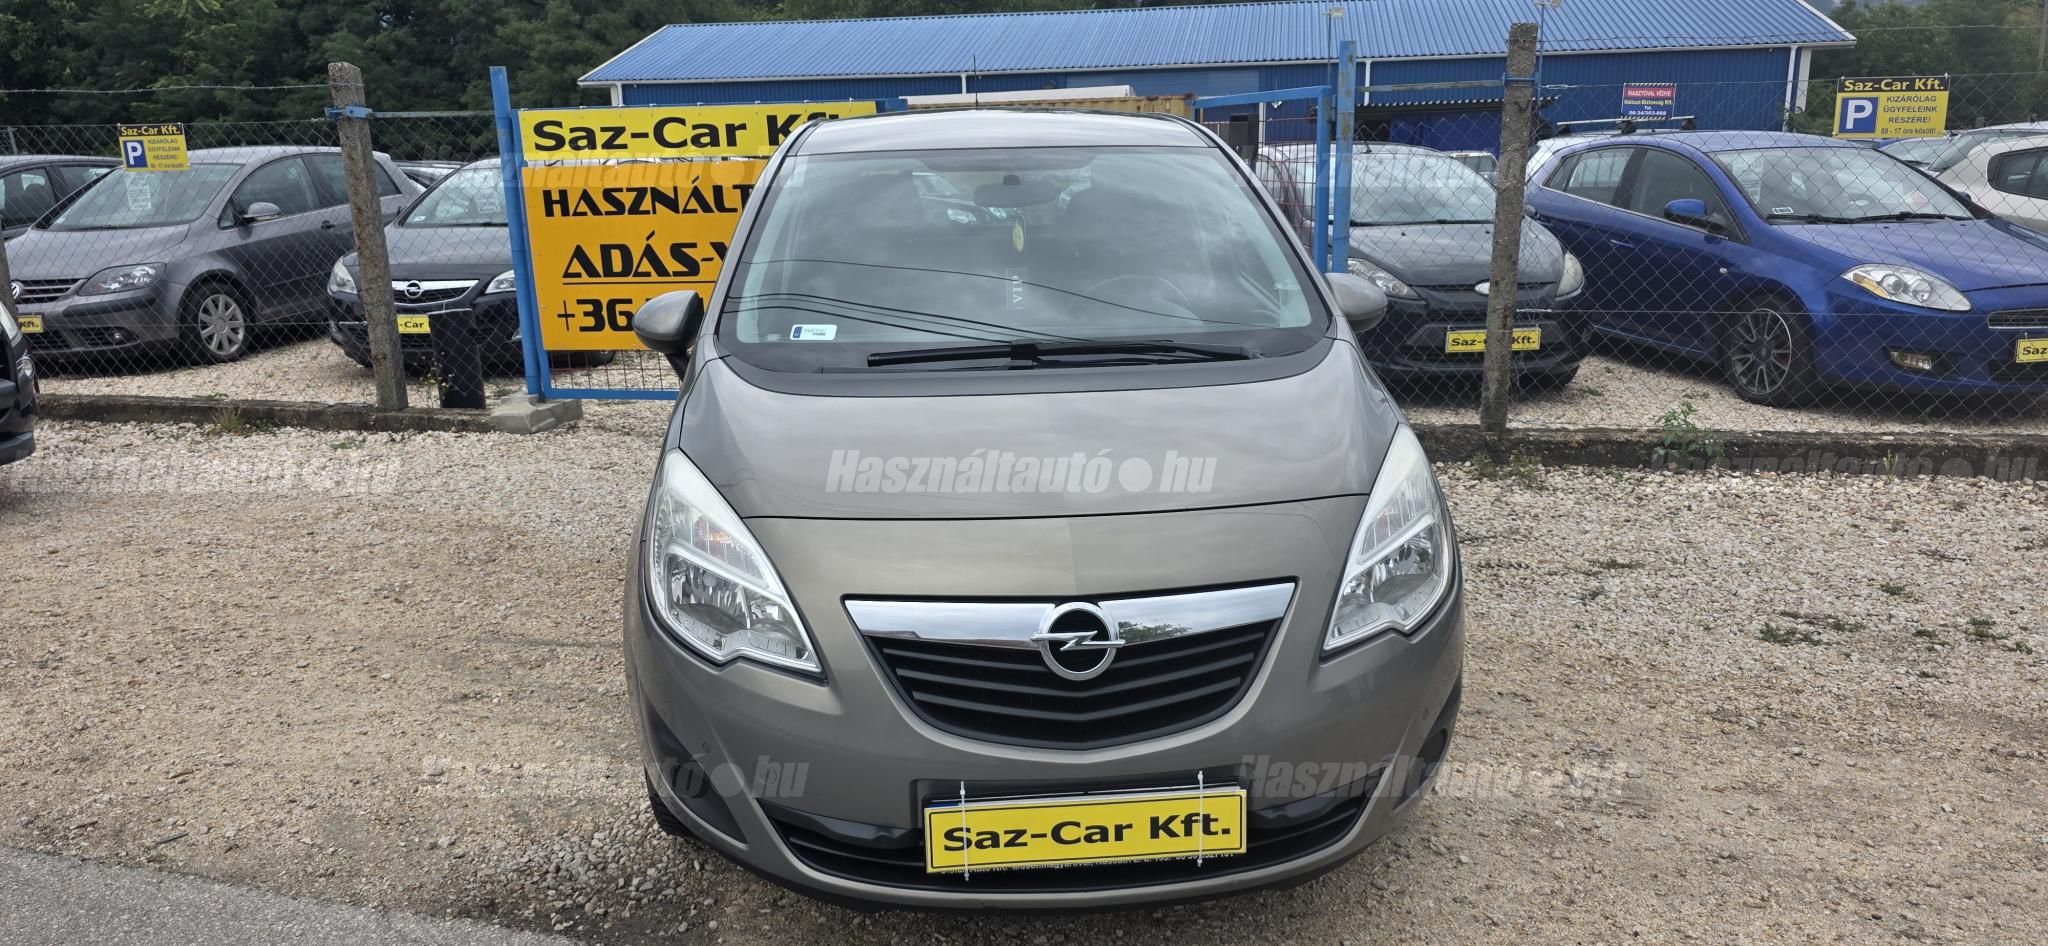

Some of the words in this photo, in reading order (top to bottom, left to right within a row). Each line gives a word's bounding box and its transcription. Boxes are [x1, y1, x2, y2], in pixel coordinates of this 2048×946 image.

[1844, 79, 1910, 91] Saz-Car
[1914, 78, 1944, 90] Kft.
[1886, 95, 1937, 103] KIZÁRÓLAG
[1846, 100, 1873, 130] P
[1883, 105, 1938, 113] ÜGYFELEINK
[1888, 115, 1931, 124] RÉSZÉRE!
[121, 126, 158, 136] Saz-Car
[160, 124, 180, 135] Kft.
[533, 117, 747, 152] Saz-Car
[126, 141, 143, 165] P
[1511, 335, 1536, 344] Kft.
[943, 820, 1133, 852] Saz-Car
[1149, 812, 1231, 840] Kft.
